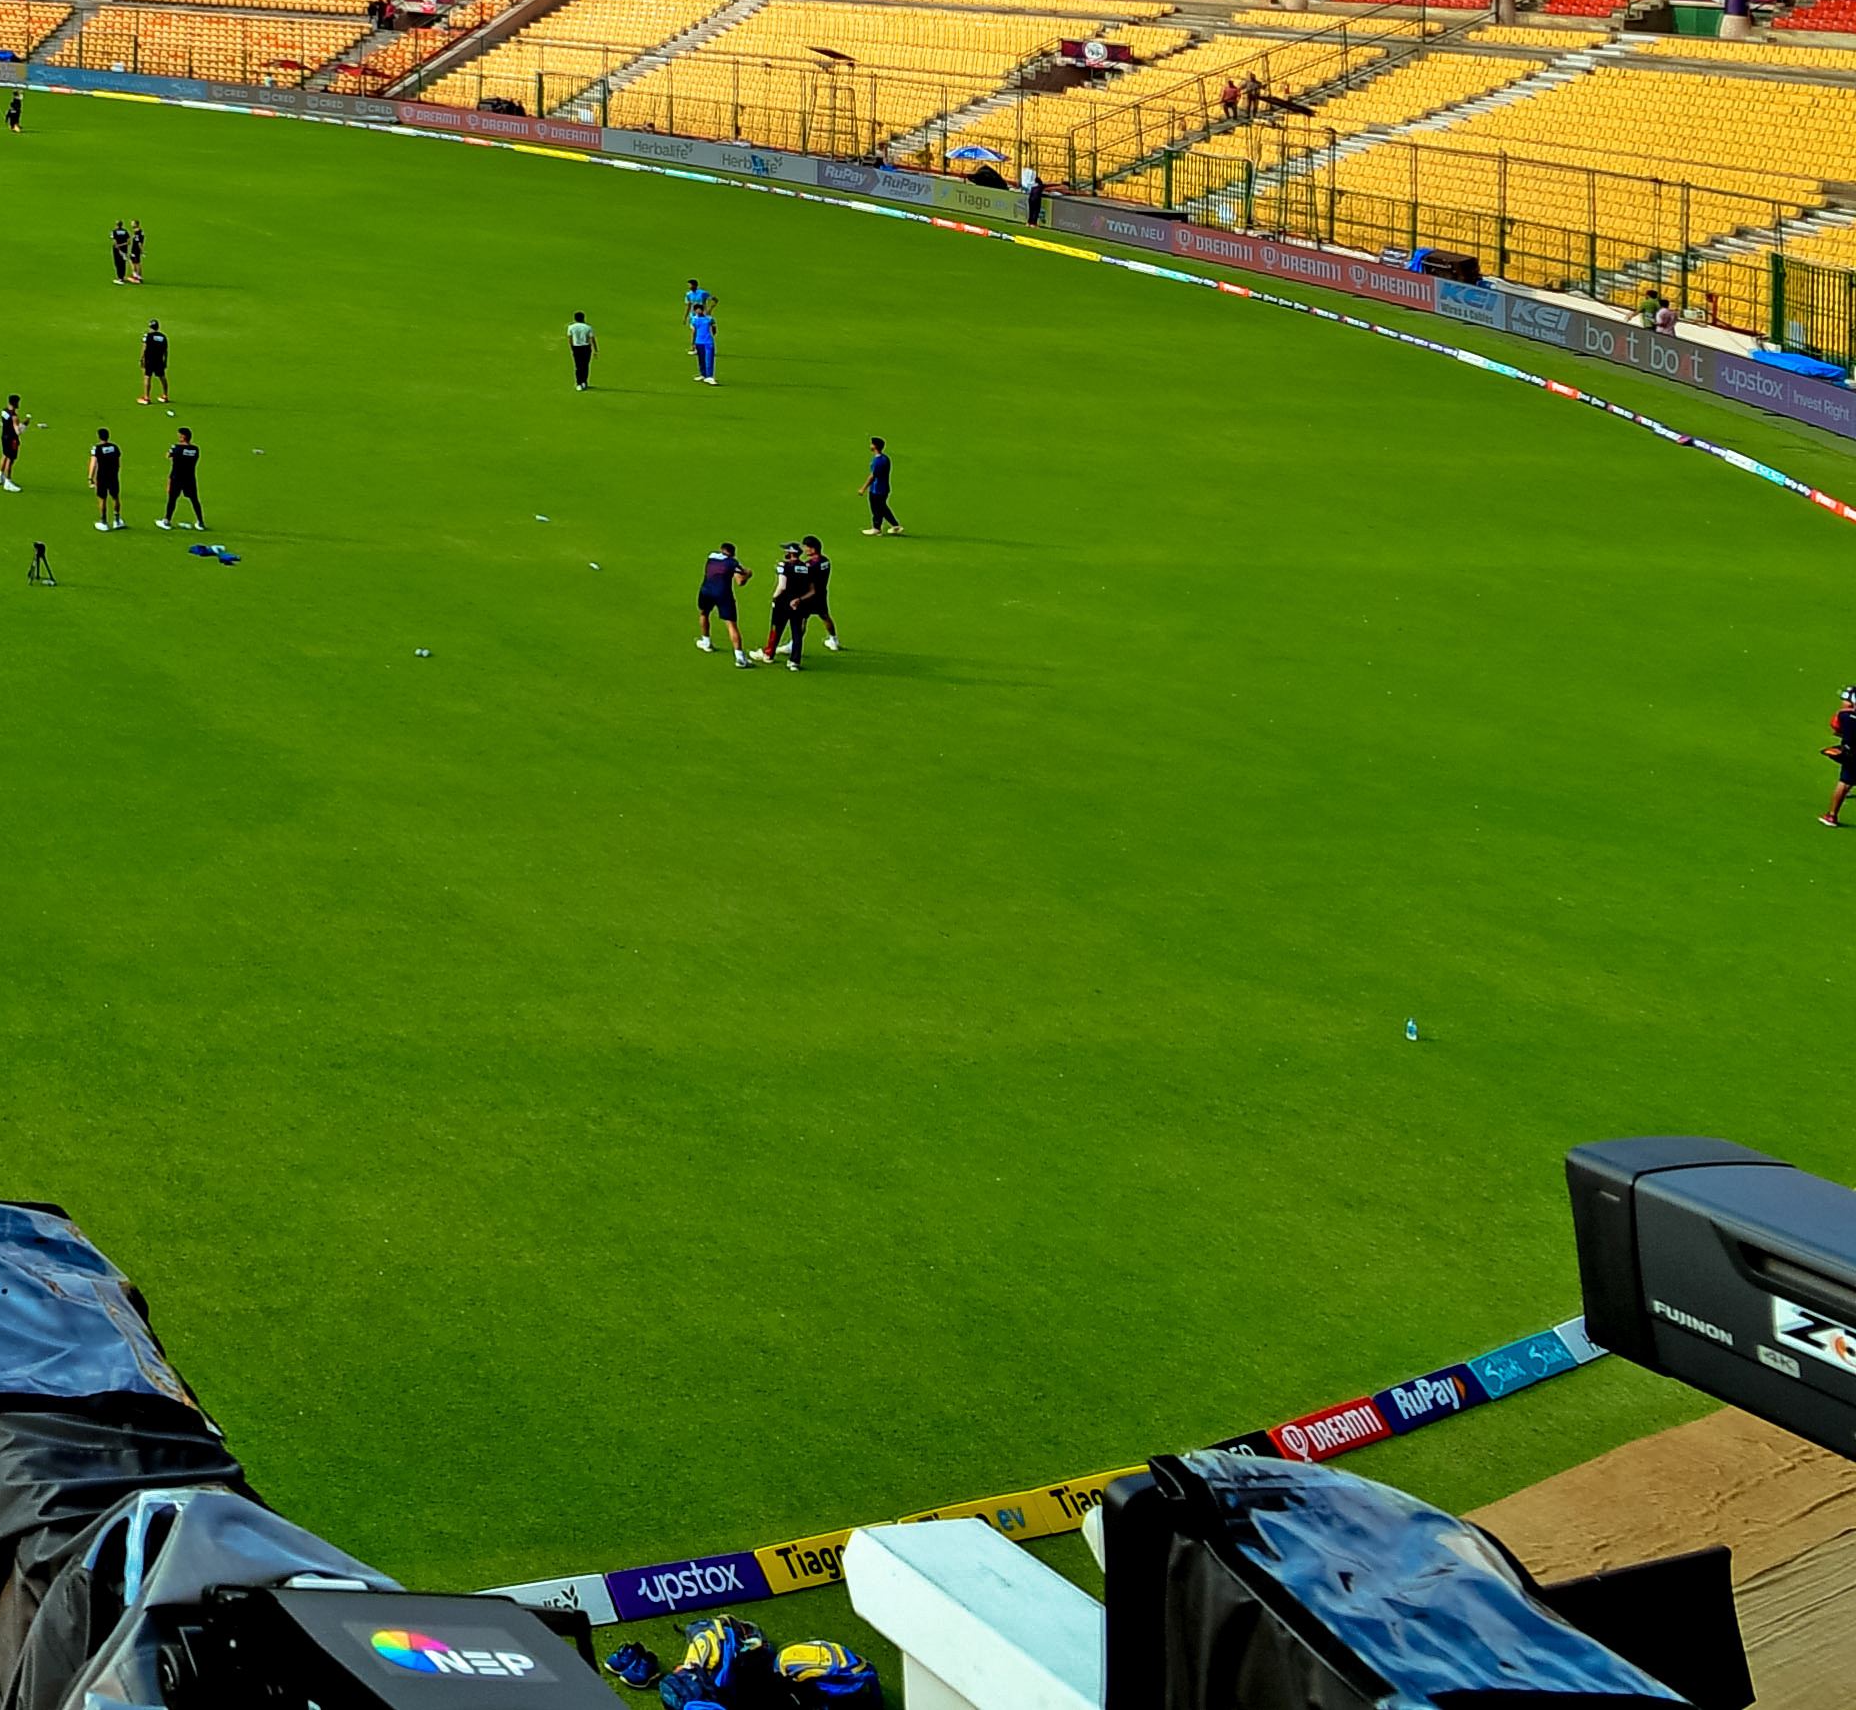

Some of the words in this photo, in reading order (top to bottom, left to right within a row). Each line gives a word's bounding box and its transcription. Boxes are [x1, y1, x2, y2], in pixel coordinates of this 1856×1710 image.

[416, 110, 460, 126] DREAM11
[481, 115, 529, 135] DREAM11
[550, 124, 599, 144] DREAM11
[632, 139, 689, 160] Herbalife
[824, 165, 868, 186] RuPay
[881, 174, 926, 198] RuPay
[956, 189, 991, 210] Tiago
[1107, 219, 1138, 236] TATA
[1140, 225, 1166, 242] NEU
[1196, 235, 1253, 261] DREAM11
[1281, 253, 1341, 281] DREAM11
[1370, 272, 1431, 302] DREAM11
[1440, 283, 1498, 311] KEI
[1511, 300, 1572, 331] KEI
[1721, 366, 1784, 400] upstox
[1793, 390, 1822, 413] Invest
[1824, 400, 1849, 421] Right
[1653, 1299, 1735, 1346] FUJINON
[1391, 1375, 1460, 1419] RuPay
[1306, 1405, 1384, 1452] DREAM11
[638, 1562, 744, 1611] upstox
[430, 1650, 537, 1678] NEP
